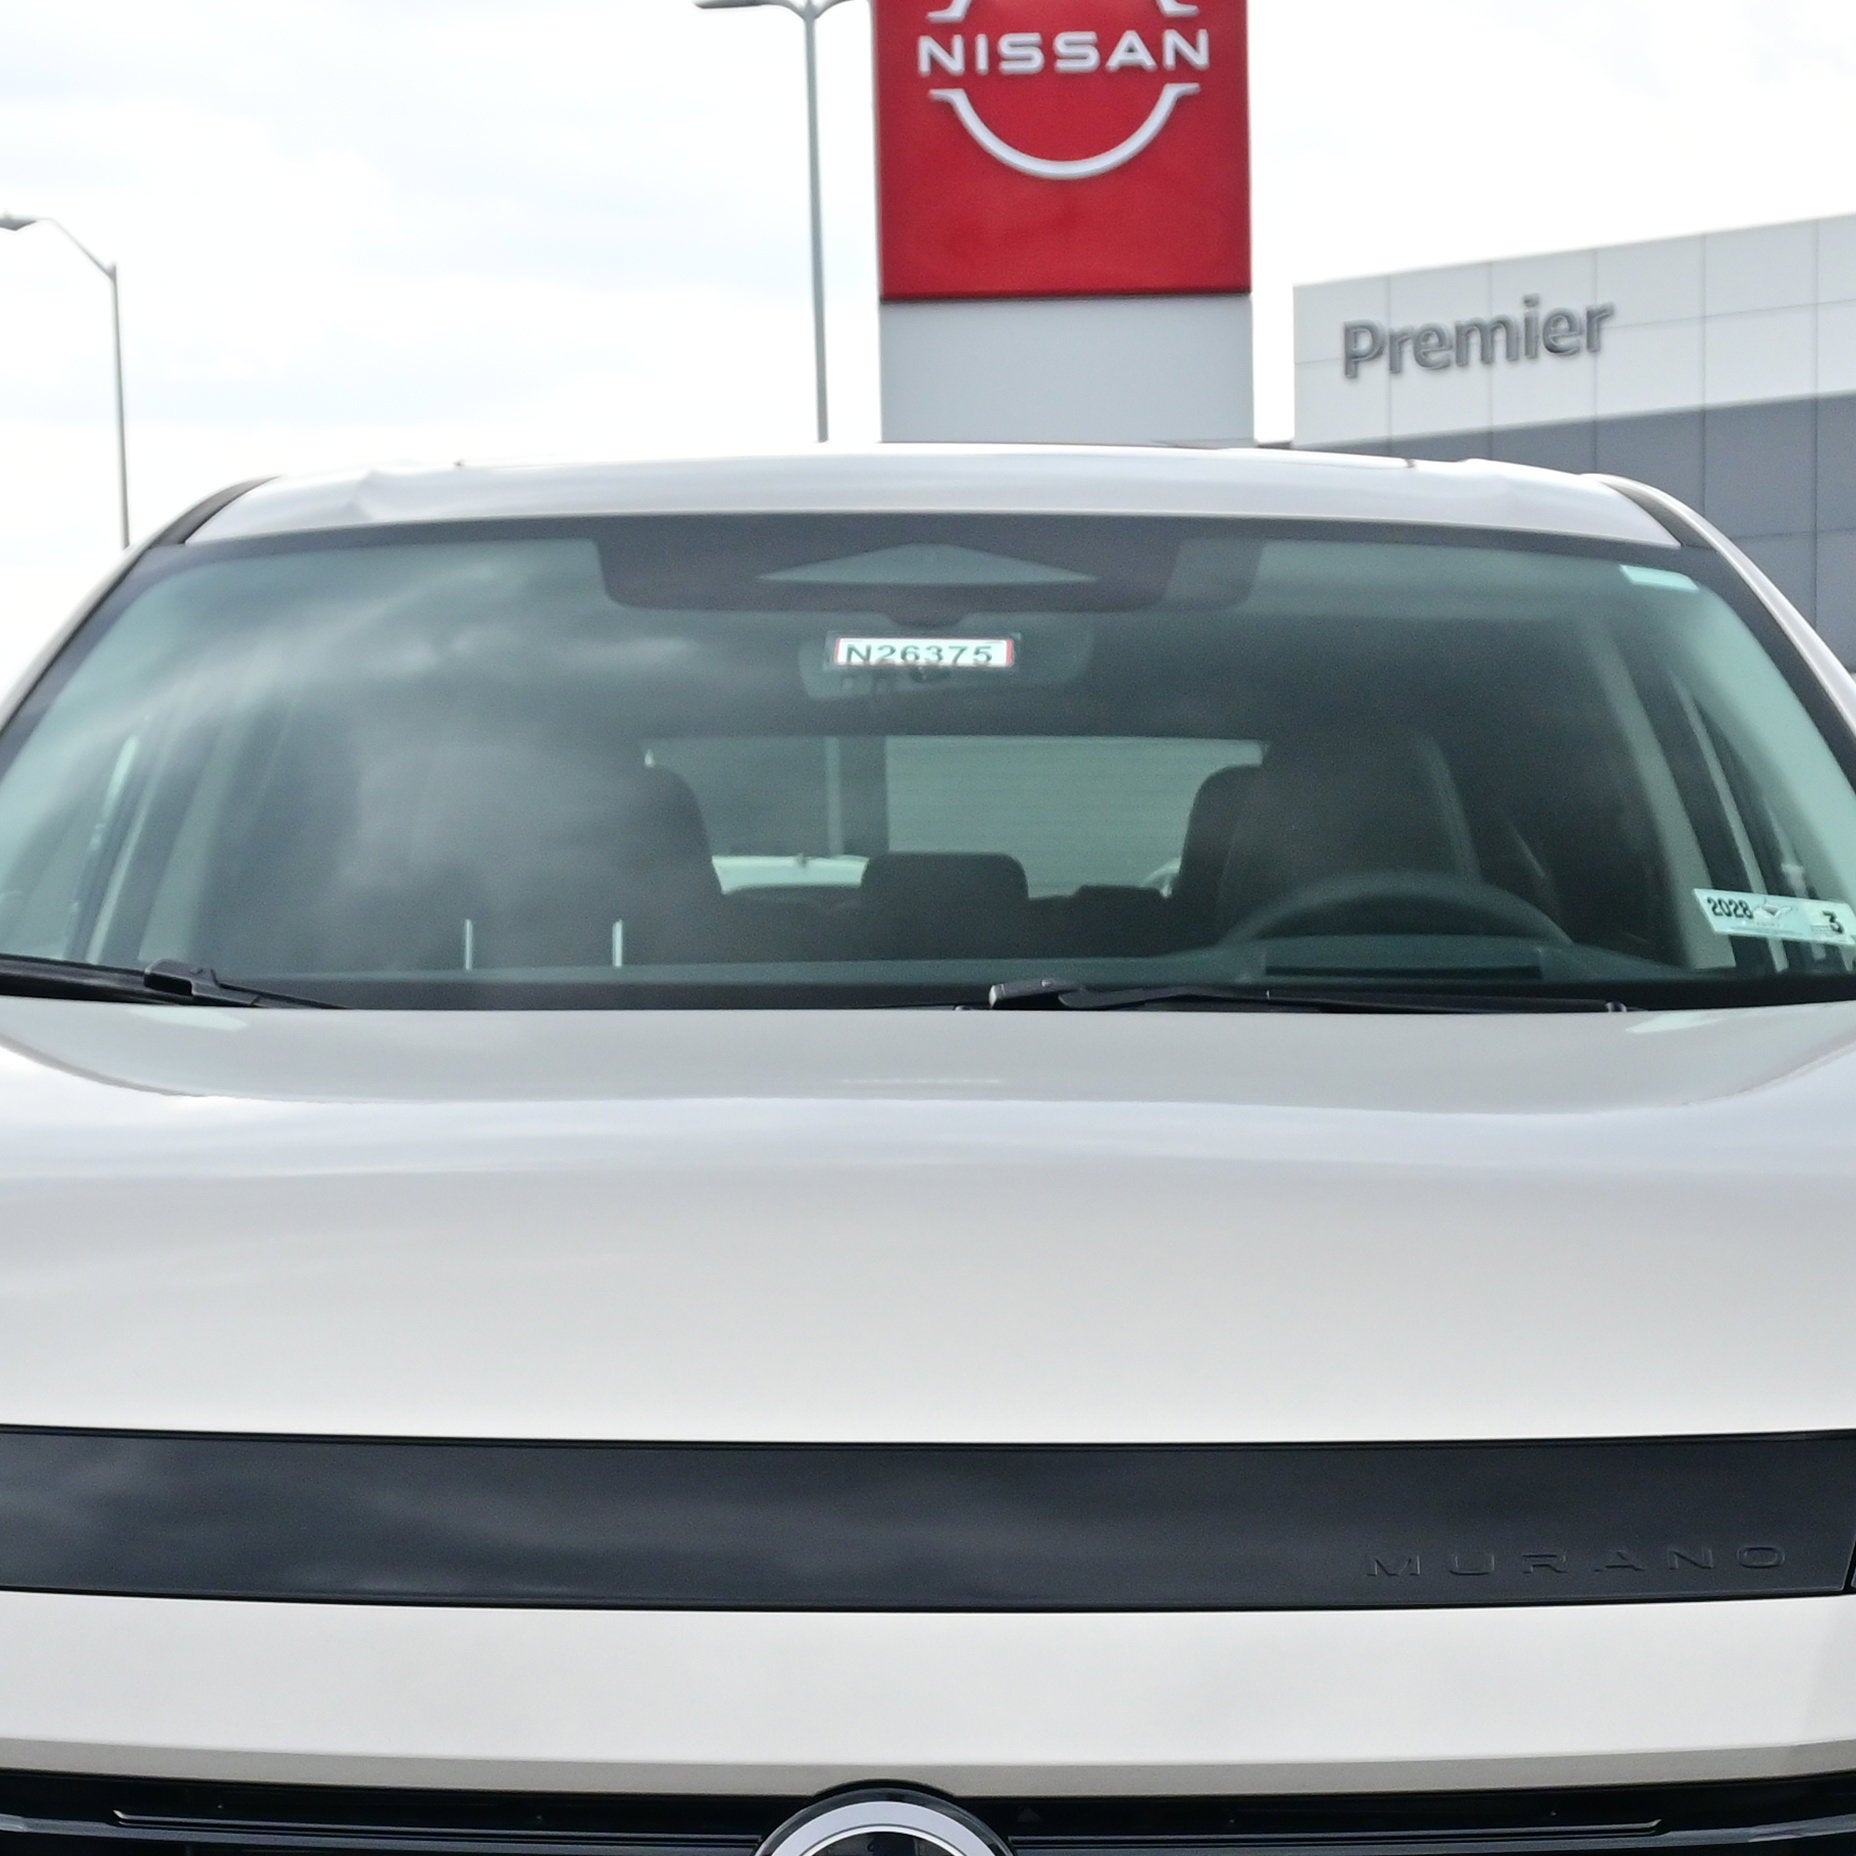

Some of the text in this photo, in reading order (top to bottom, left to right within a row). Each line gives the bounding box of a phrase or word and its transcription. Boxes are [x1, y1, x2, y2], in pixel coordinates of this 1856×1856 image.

[917, 28, 1210, 77] NISSAN
[1344, 294, 1614, 378] Premier
[845, 643, 994, 665] N26375
[1706, 897, 1755, 920] 2028
[1822, 910, 1845, 935] 3
[1364, 1545, 1787, 1578] MURANO
